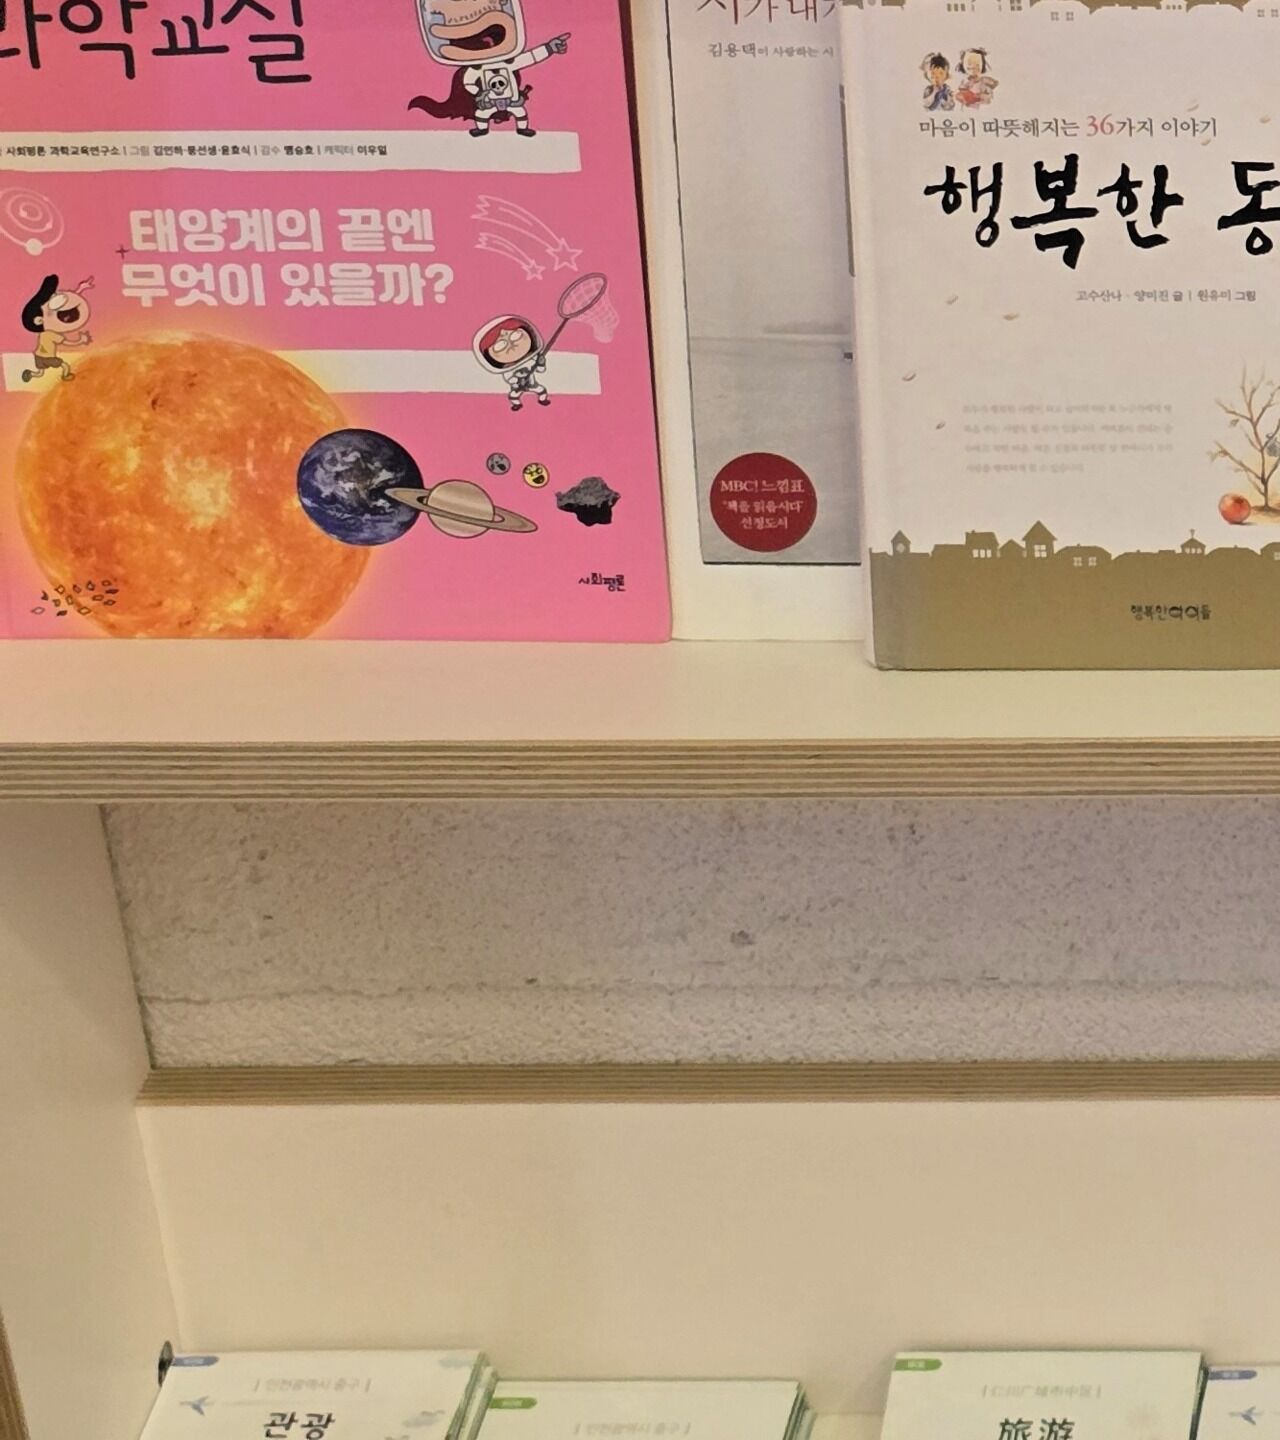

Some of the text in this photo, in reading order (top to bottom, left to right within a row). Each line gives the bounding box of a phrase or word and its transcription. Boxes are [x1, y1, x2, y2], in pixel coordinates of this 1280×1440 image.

[708, 42, 769, 58] 김용택이
[918, 112, 1218, 139] 마음이 따뜻해지는 36가지 이야기
[923, 152, 1184, 270] 행복한
[128, 208, 437, 254] 태양계의 끝엔
[121, 262, 455, 308] 무엇이 있을까?
[761, 478, 806, 494] 느낌표
[741, 515, 789, 530] 선정도서
[577, 571, 627, 593] 사회평론
[262, 1410, 336, 1440] 관광
